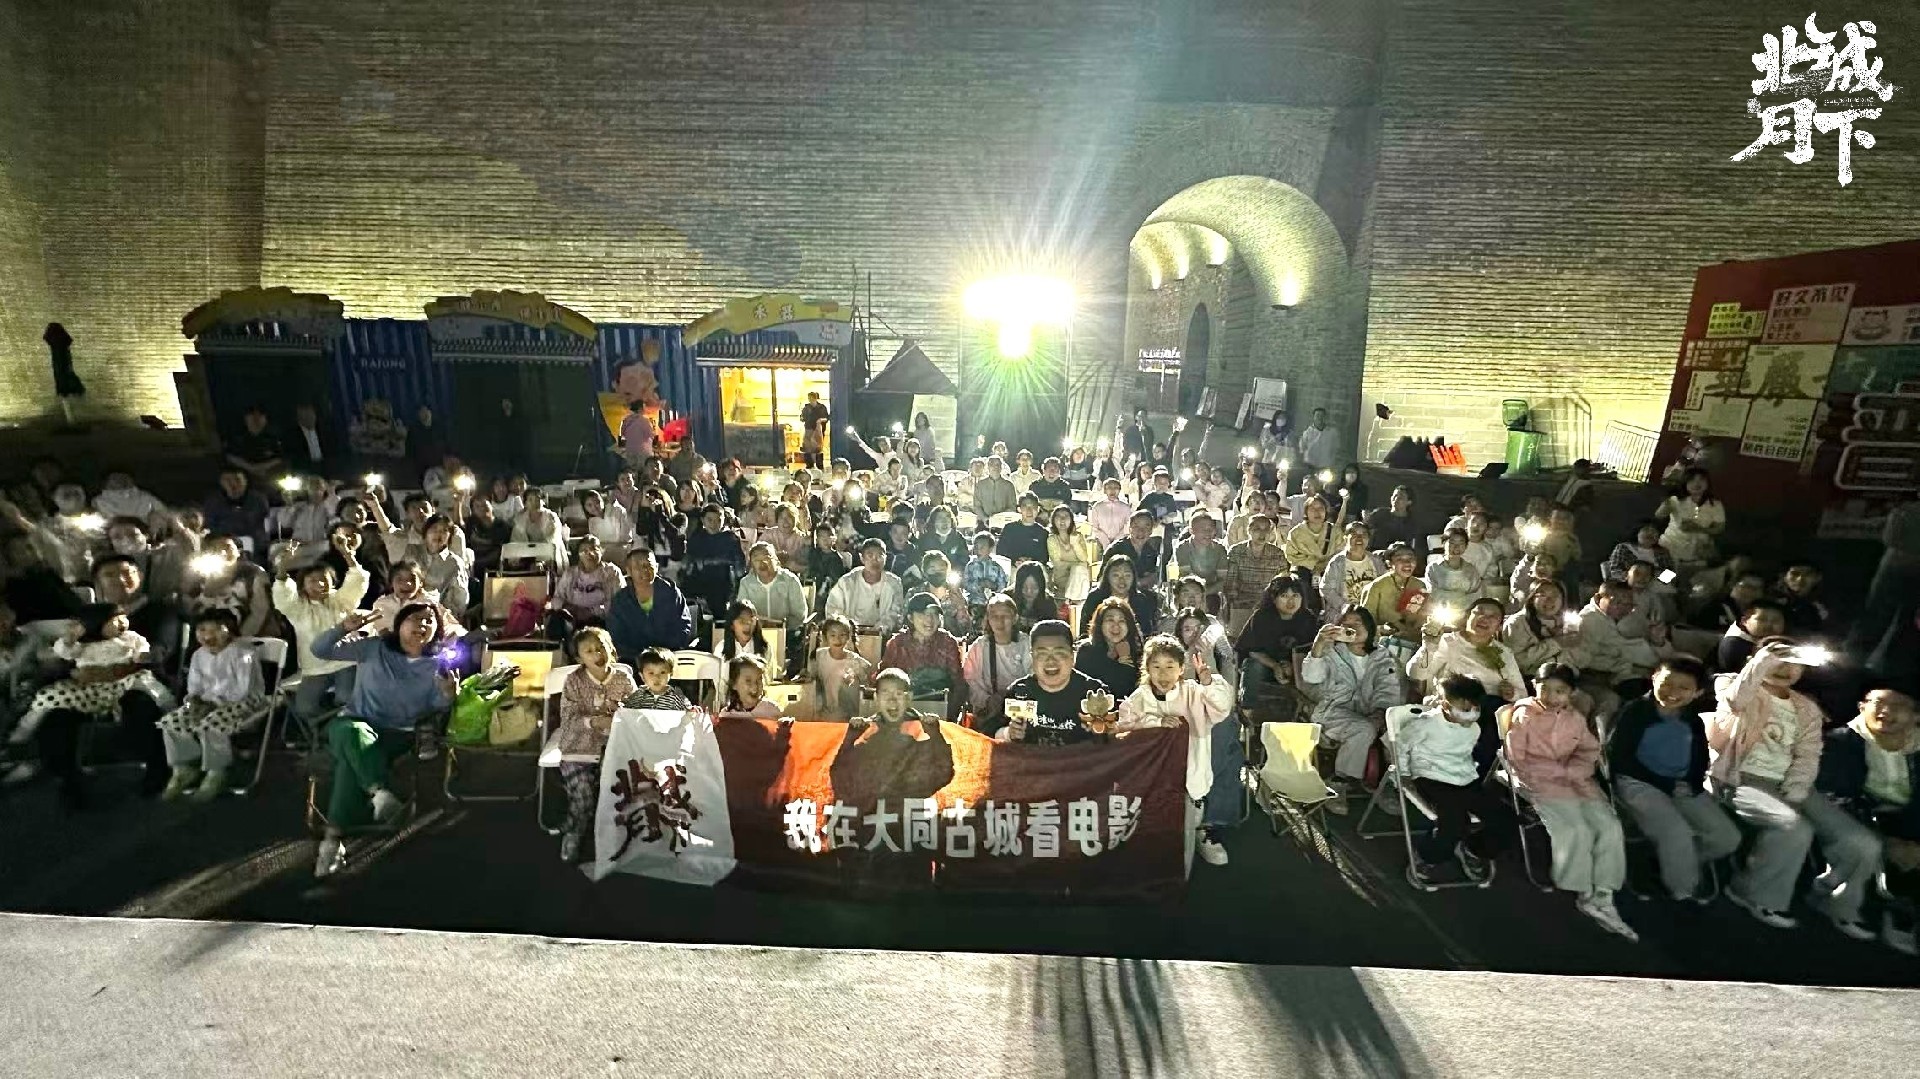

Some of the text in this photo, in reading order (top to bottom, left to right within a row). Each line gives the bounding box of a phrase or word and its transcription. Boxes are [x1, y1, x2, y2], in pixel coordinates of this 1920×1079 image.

[784, 796, 1142, 857] 我在大同古城看电影
